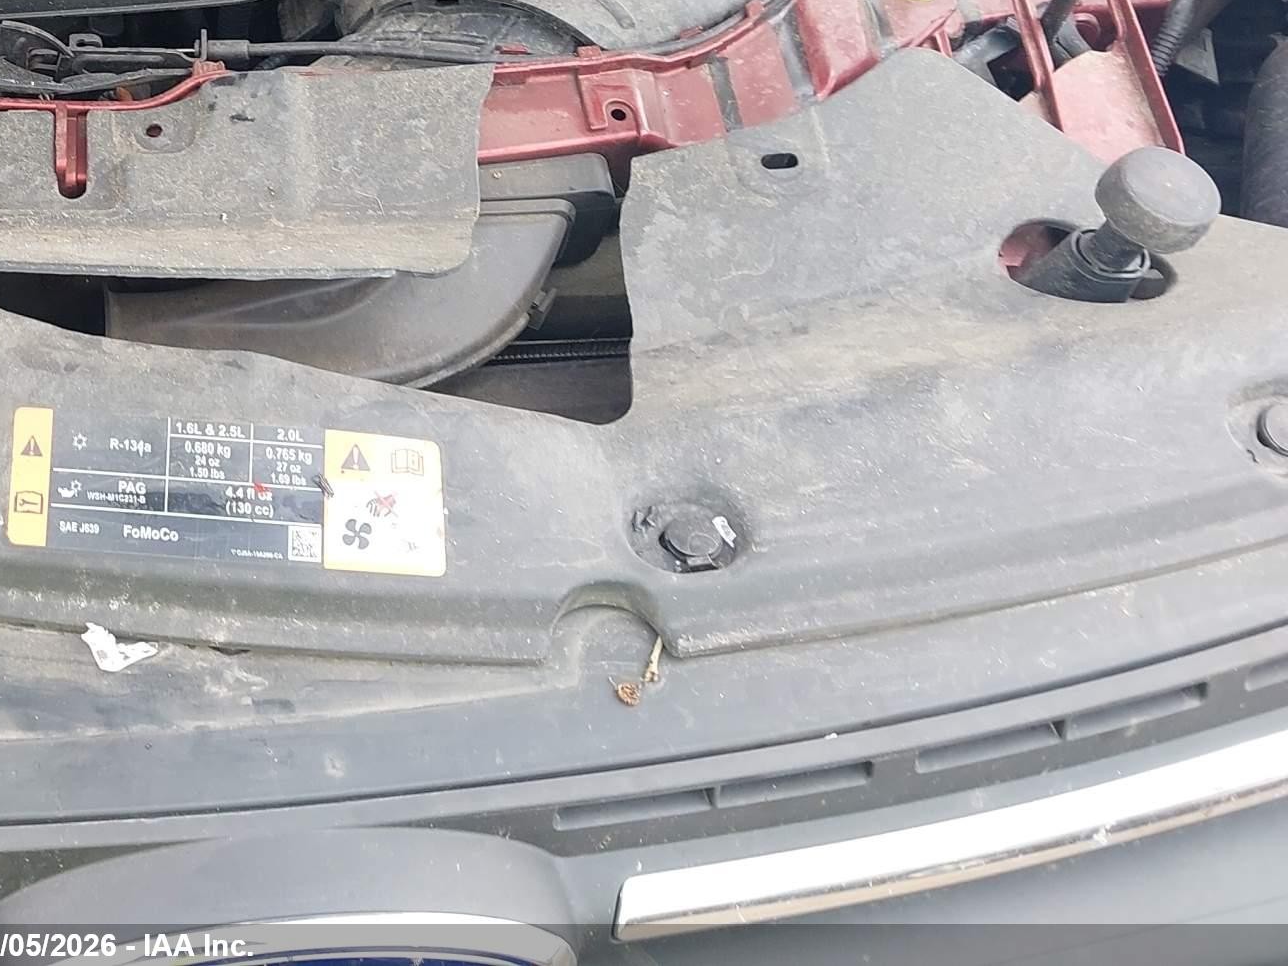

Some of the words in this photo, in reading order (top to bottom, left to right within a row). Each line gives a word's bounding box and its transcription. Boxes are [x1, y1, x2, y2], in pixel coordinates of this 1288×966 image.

[176, 422, 202, 435] 1.6L
[205, 424, 215, 436] &
[218, 425, 246, 438] 2.5L
[276, 428, 304, 442] 2.0L
[109, 438, 152, 454] R-134a
[184, 441, 215, 455] 0.680
[217, 443, 232, 458] kg
[194, 455, 207, 466] 24
[208, 458, 221, 468] oz
[265, 447, 297, 462] 0.765
[298, 450, 313, 465] kg
[189, 466, 210, 478] 1.50
[210, 468, 226, 480] lbs
[276, 462, 288, 473] 27
[289, 464, 302, 474] oz
[270, 473, 291, 484] 1.69
[292, 474, 307, 486] lbs
[118, 480, 147, 495] PAG
[225, 486, 244, 499] 4.4
[246, 487, 255, 499] fl
[257, 490, 273, 501] oz
[225, 501, 252, 516] (130
[254, 504, 274, 518] cc)
[59, 520, 78, 533] SAE
[79, 522, 100, 534] J639
[123, 524, 179, 542] FoMoCo
